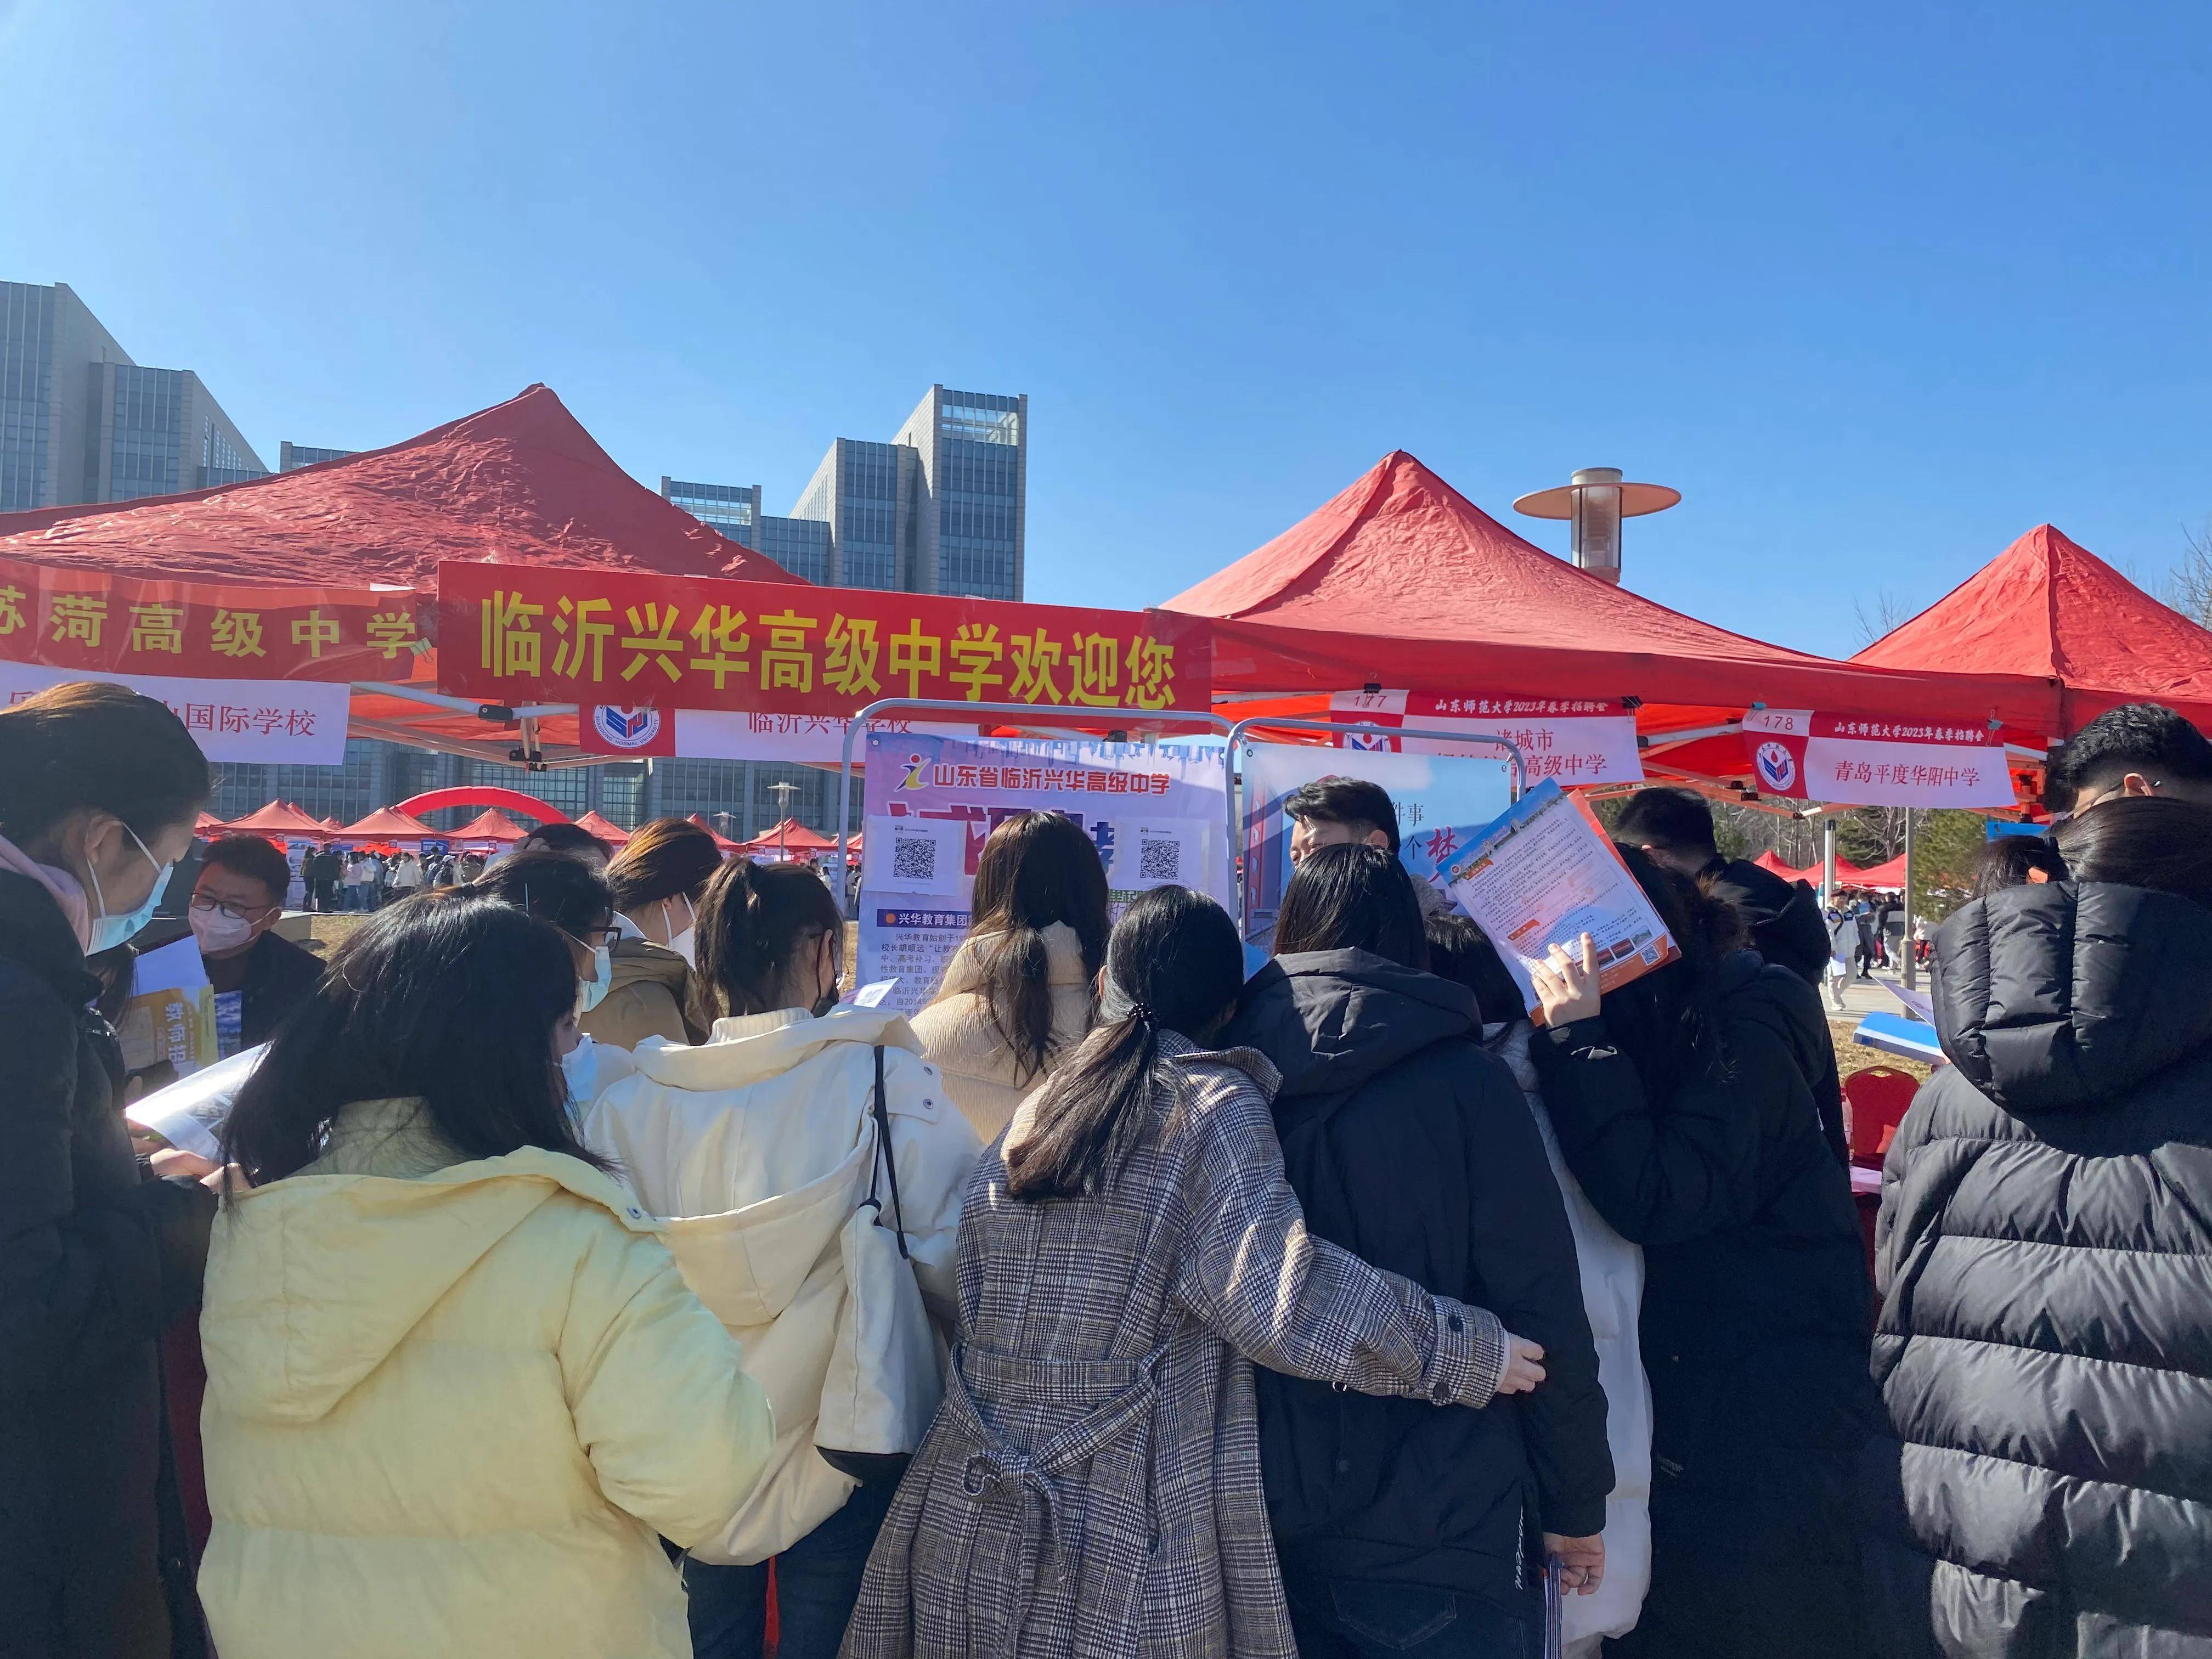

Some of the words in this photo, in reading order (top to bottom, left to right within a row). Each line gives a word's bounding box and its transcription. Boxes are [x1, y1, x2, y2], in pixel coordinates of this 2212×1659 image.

[481, 590, 1175, 710] 临沂兴华高级中学欢迎您
[1354, 695, 1387, 708] 177
[1435, 699, 1609, 714] 山东师范大学2023年春季招聘会
[163, 700, 317, 736] 国际学校
[595, 715, 613, 741] SHANDONG
[639, 719, 659, 743] UNIVERSITY
[1764, 715, 1793, 731] 178
[1495, 728, 1553, 752] 诸城市
[1835, 721, 1984, 742] 山东师范大学2023年春季招聘会
[934, 765, 1170, 795] 山东省临沂兴华高级中学
[1835, 760, 1980, 787] 青岛平度华阳中学
[881, 965, 947, 974] 性教育集团。现
